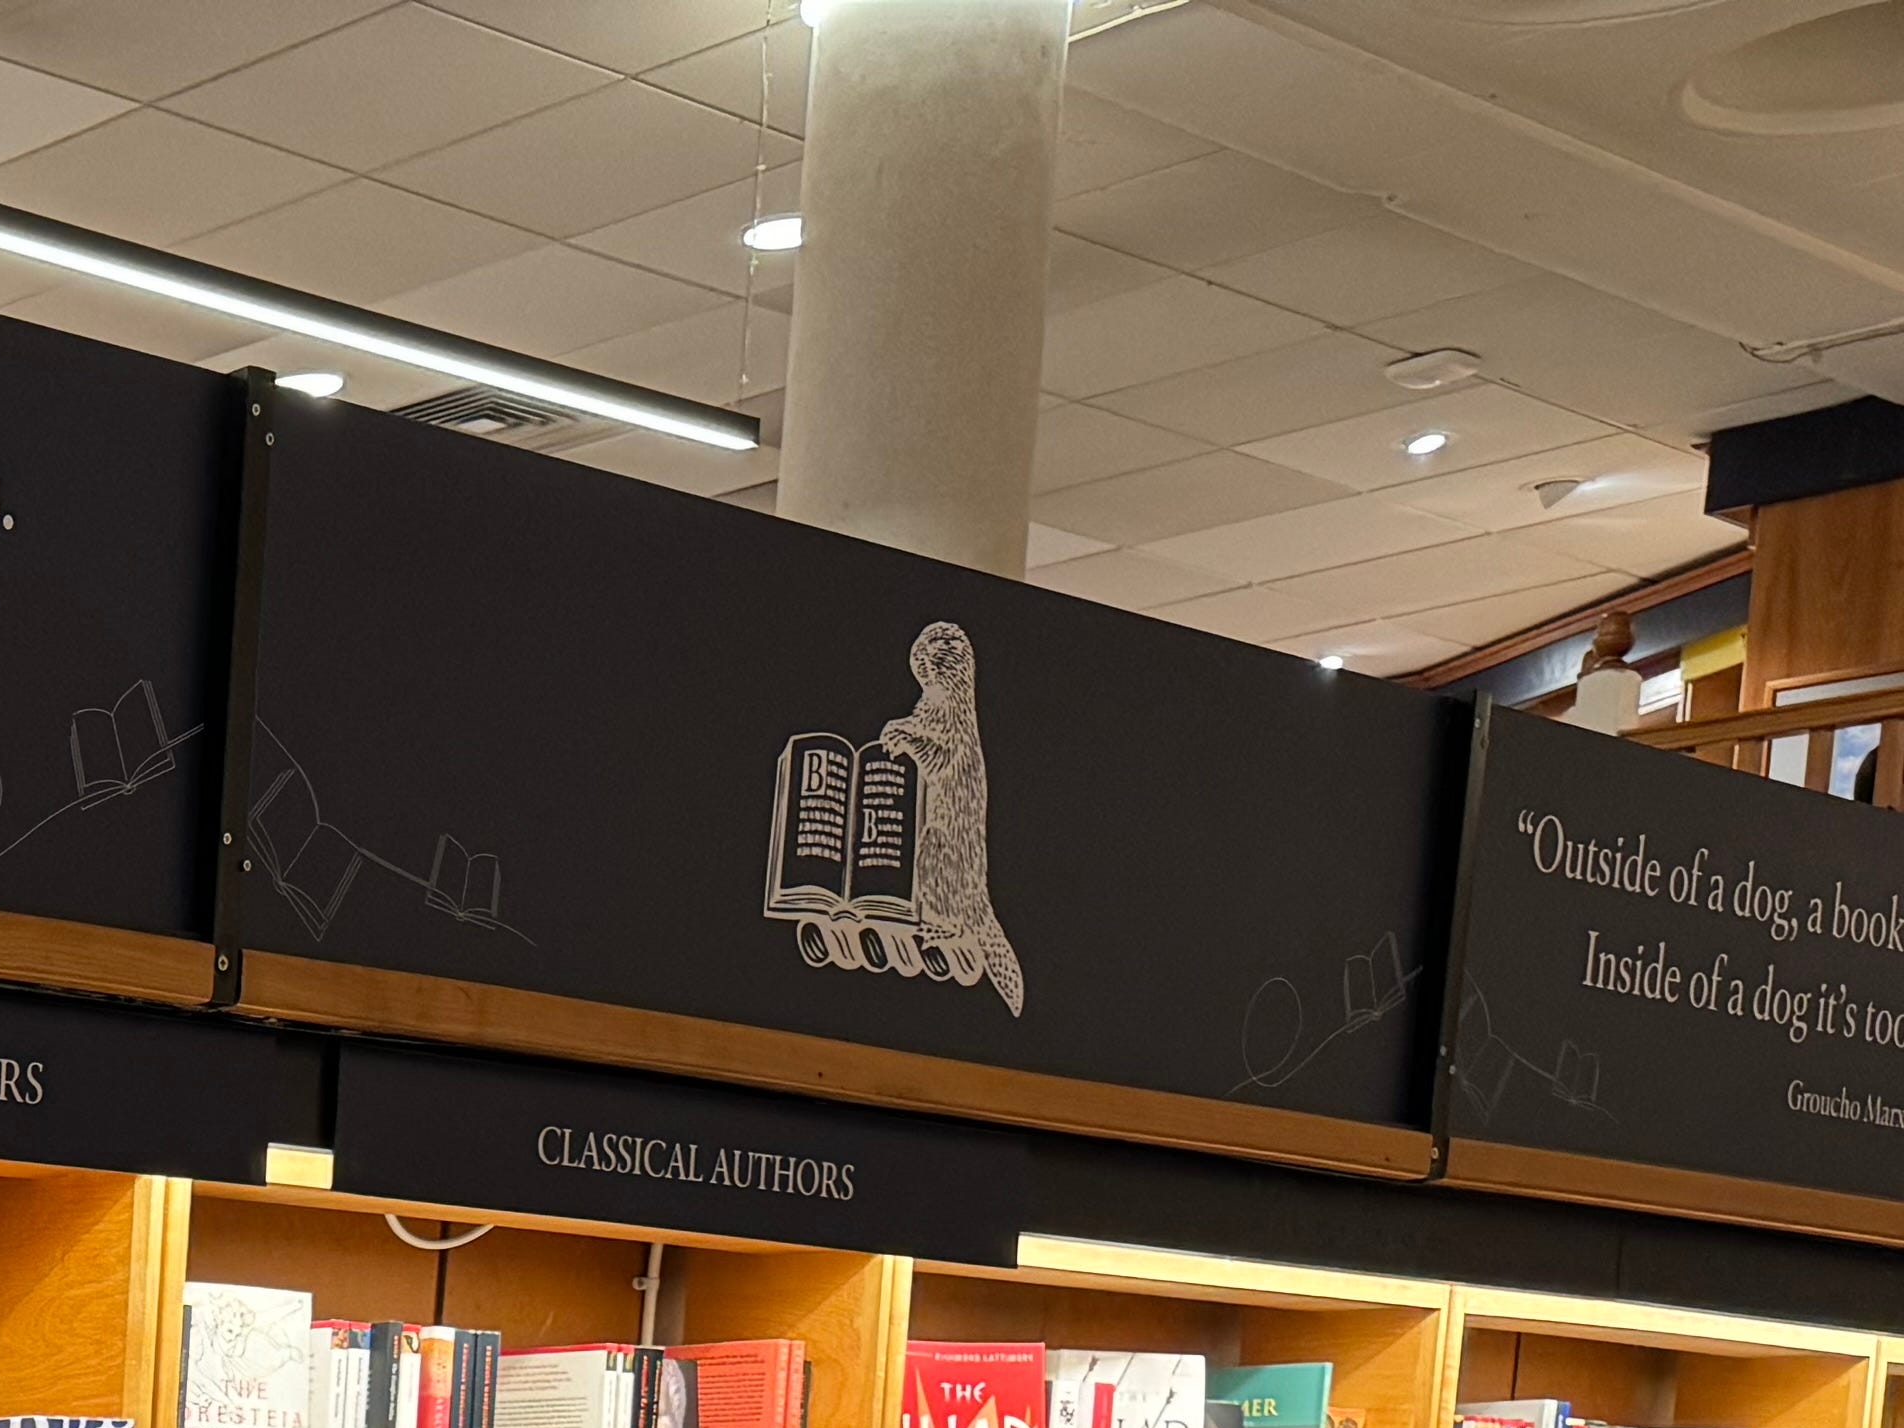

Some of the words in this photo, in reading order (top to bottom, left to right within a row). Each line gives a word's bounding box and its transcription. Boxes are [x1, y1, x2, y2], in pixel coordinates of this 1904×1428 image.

[1670, 848, 1708, 905] of
[1708, 875, 1723, 912] a
[1734, 861, 1798, 941] dog,
[1807, 898, 1822, 934] a
[1583, 931, 1680, 1002] Inside
[1690, 954, 1728, 1010] of
[1728, 980, 1743, 1016] a
[1753, 964, 1812, 1043] dog
[1788, 1080, 1860, 1120] Groucho
[538, 1127, 703, 1181] CLASSICAL
[710, 1149, 854, 1200] AUTHORS
[940, 1381, 986, 1404] THE
